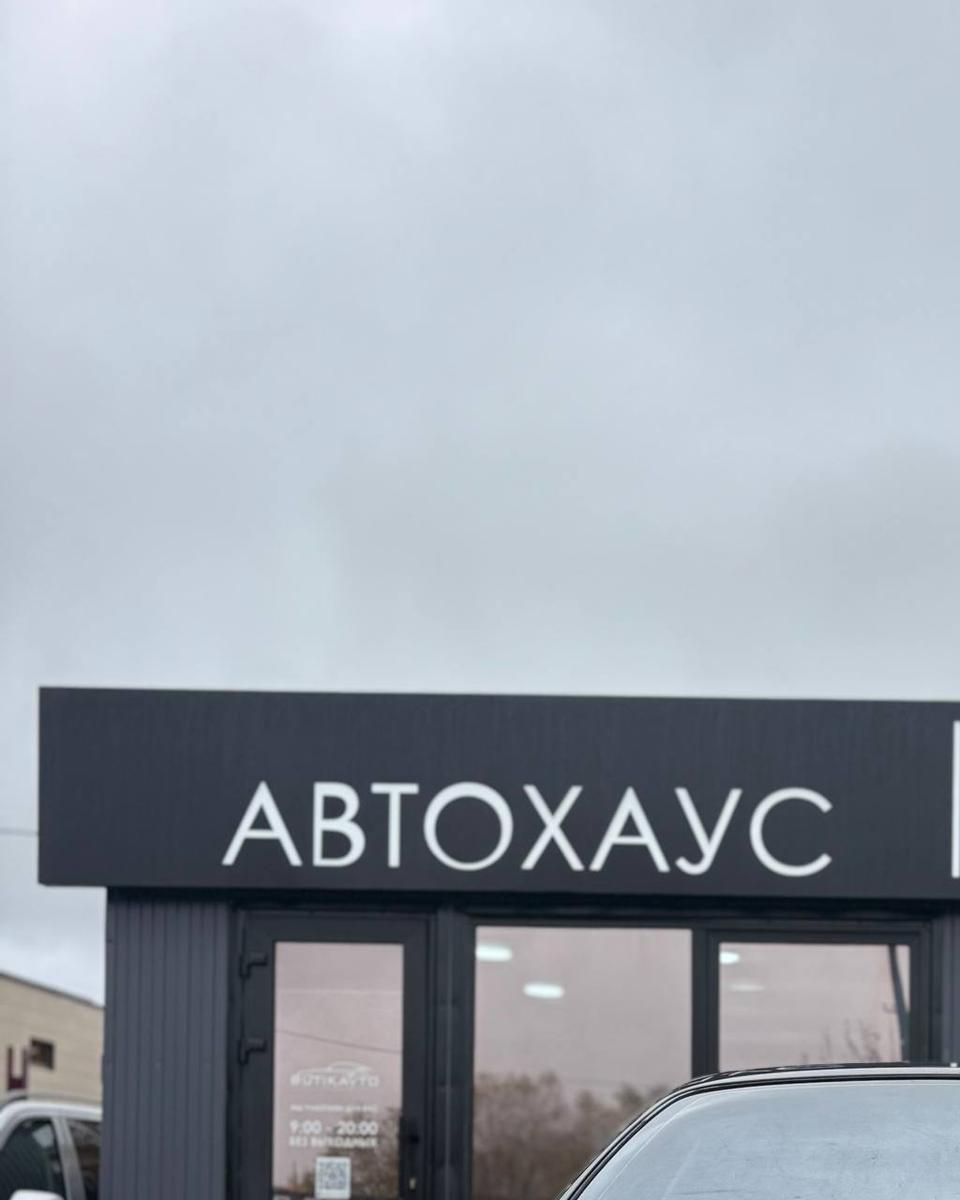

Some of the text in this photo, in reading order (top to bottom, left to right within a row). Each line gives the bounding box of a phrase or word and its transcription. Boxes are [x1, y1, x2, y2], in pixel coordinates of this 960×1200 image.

[222, 781, 833, 877] АВТОХАУС
[289, 1120, 322, 1135] 9:00
[337, 1120, 379, 1136] 20:00
